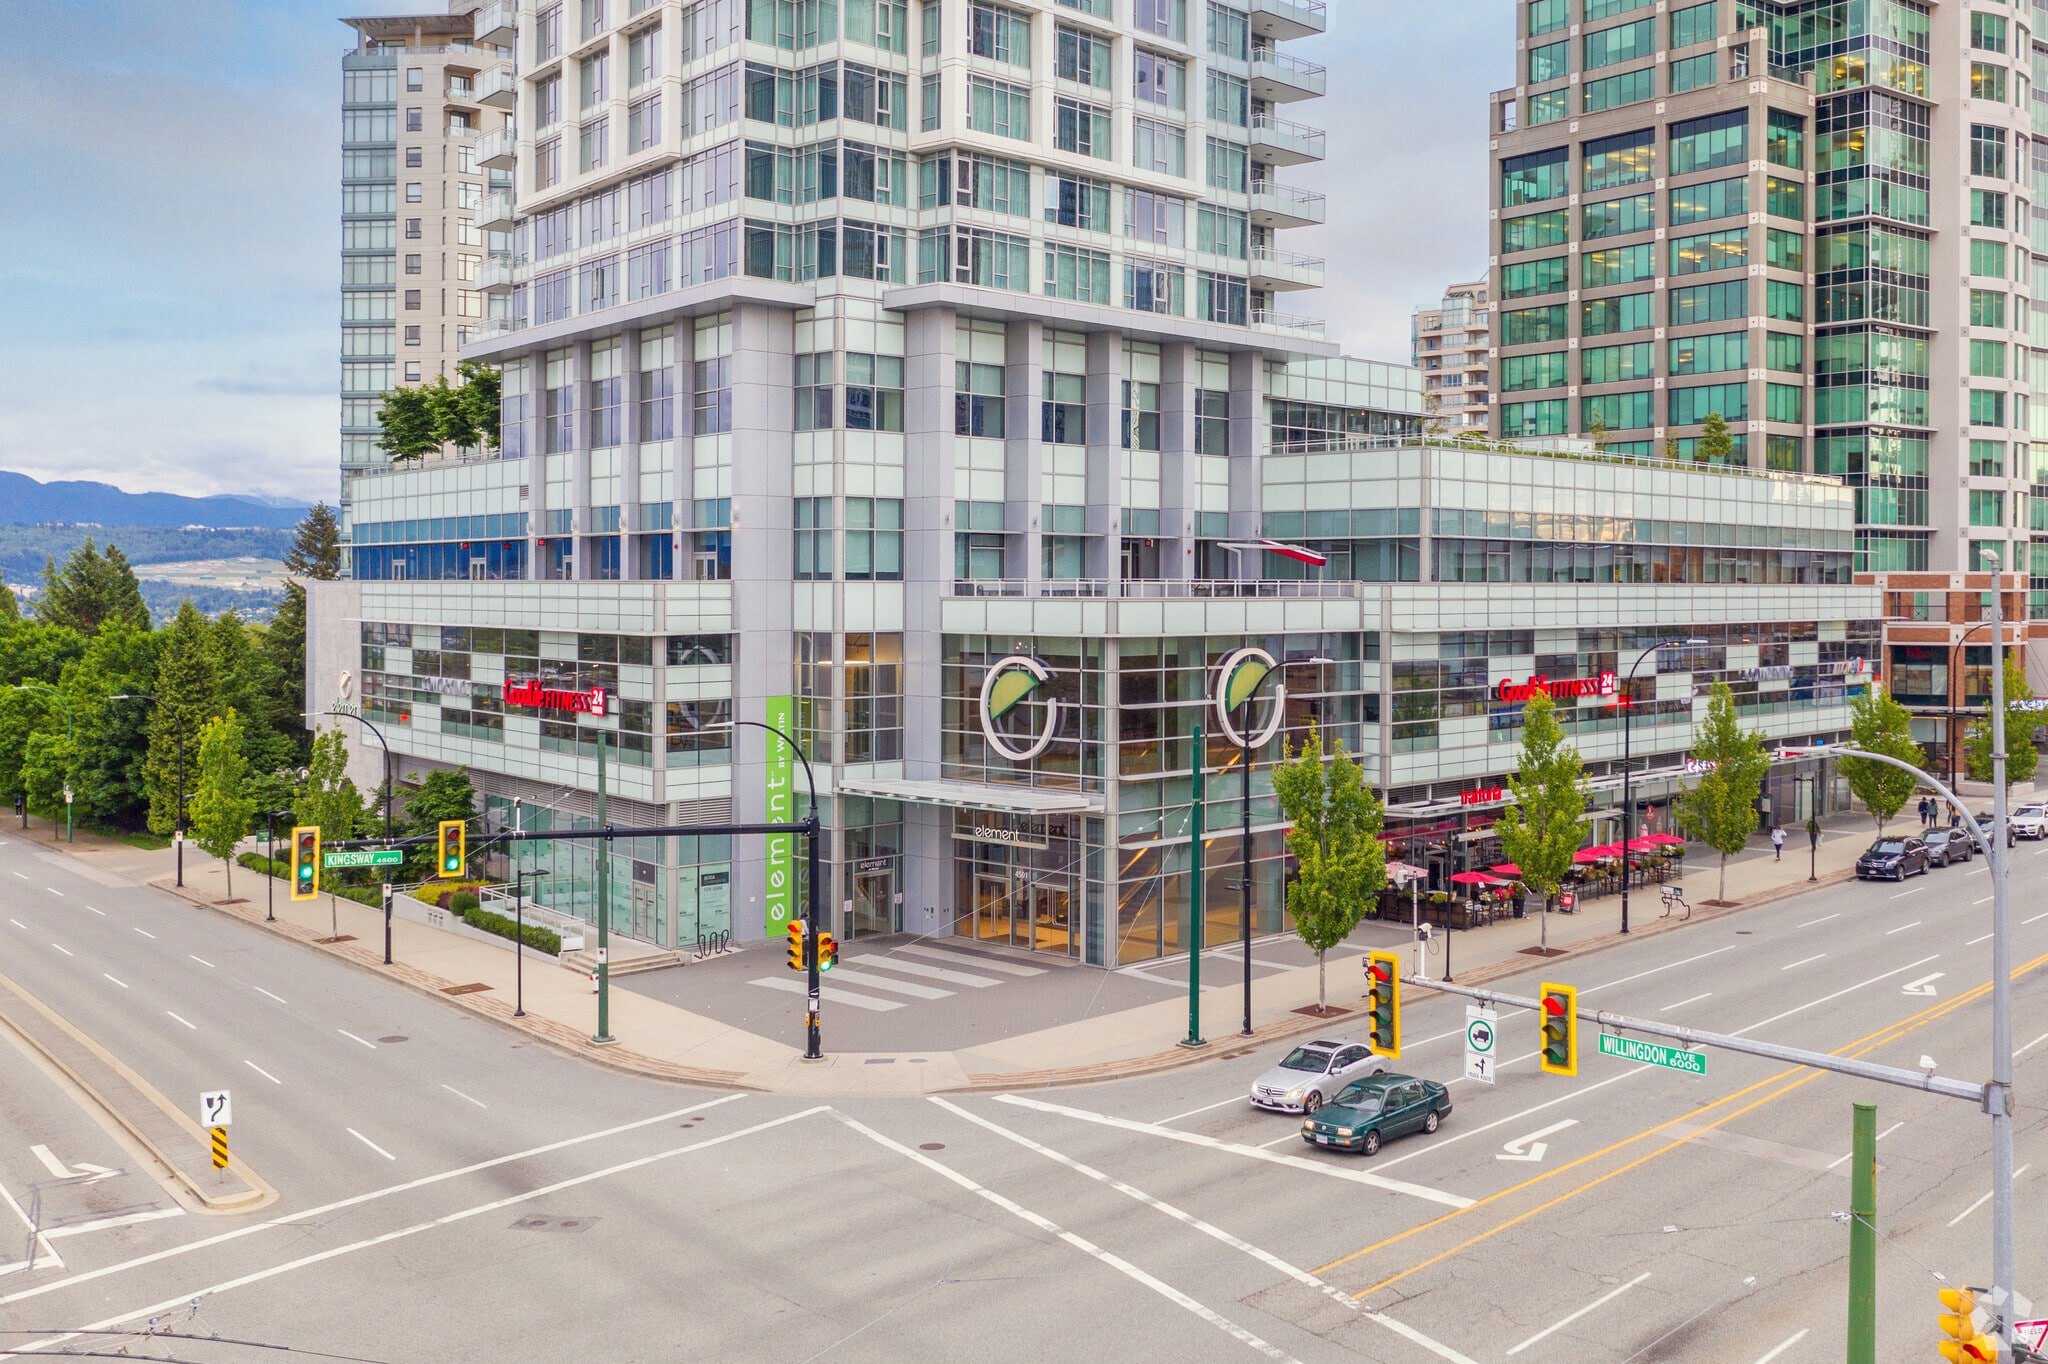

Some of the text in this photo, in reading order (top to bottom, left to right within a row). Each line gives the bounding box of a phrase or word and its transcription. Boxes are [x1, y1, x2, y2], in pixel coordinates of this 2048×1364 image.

[1602, 674, 1612, 686] 24
[1551, 678, 1598, 699] FITNESS
[503, 679, 545, 707] GoodLife
[545, 689, 591, 714] FITNESS
[593, 690, 603, 704] 24
[778, 755, 785, 768] BY
[1461, 783, 1503, 805] trattoria
[976, 825, 1020, 841] element
[327, 853, 375, 866] KINGSWAY
[860, 859, 887, 869] element
[1603, 1036, 1696, 1065] WILLINGDON AVE
[1670, 1058, 1700, 1071] 6000
